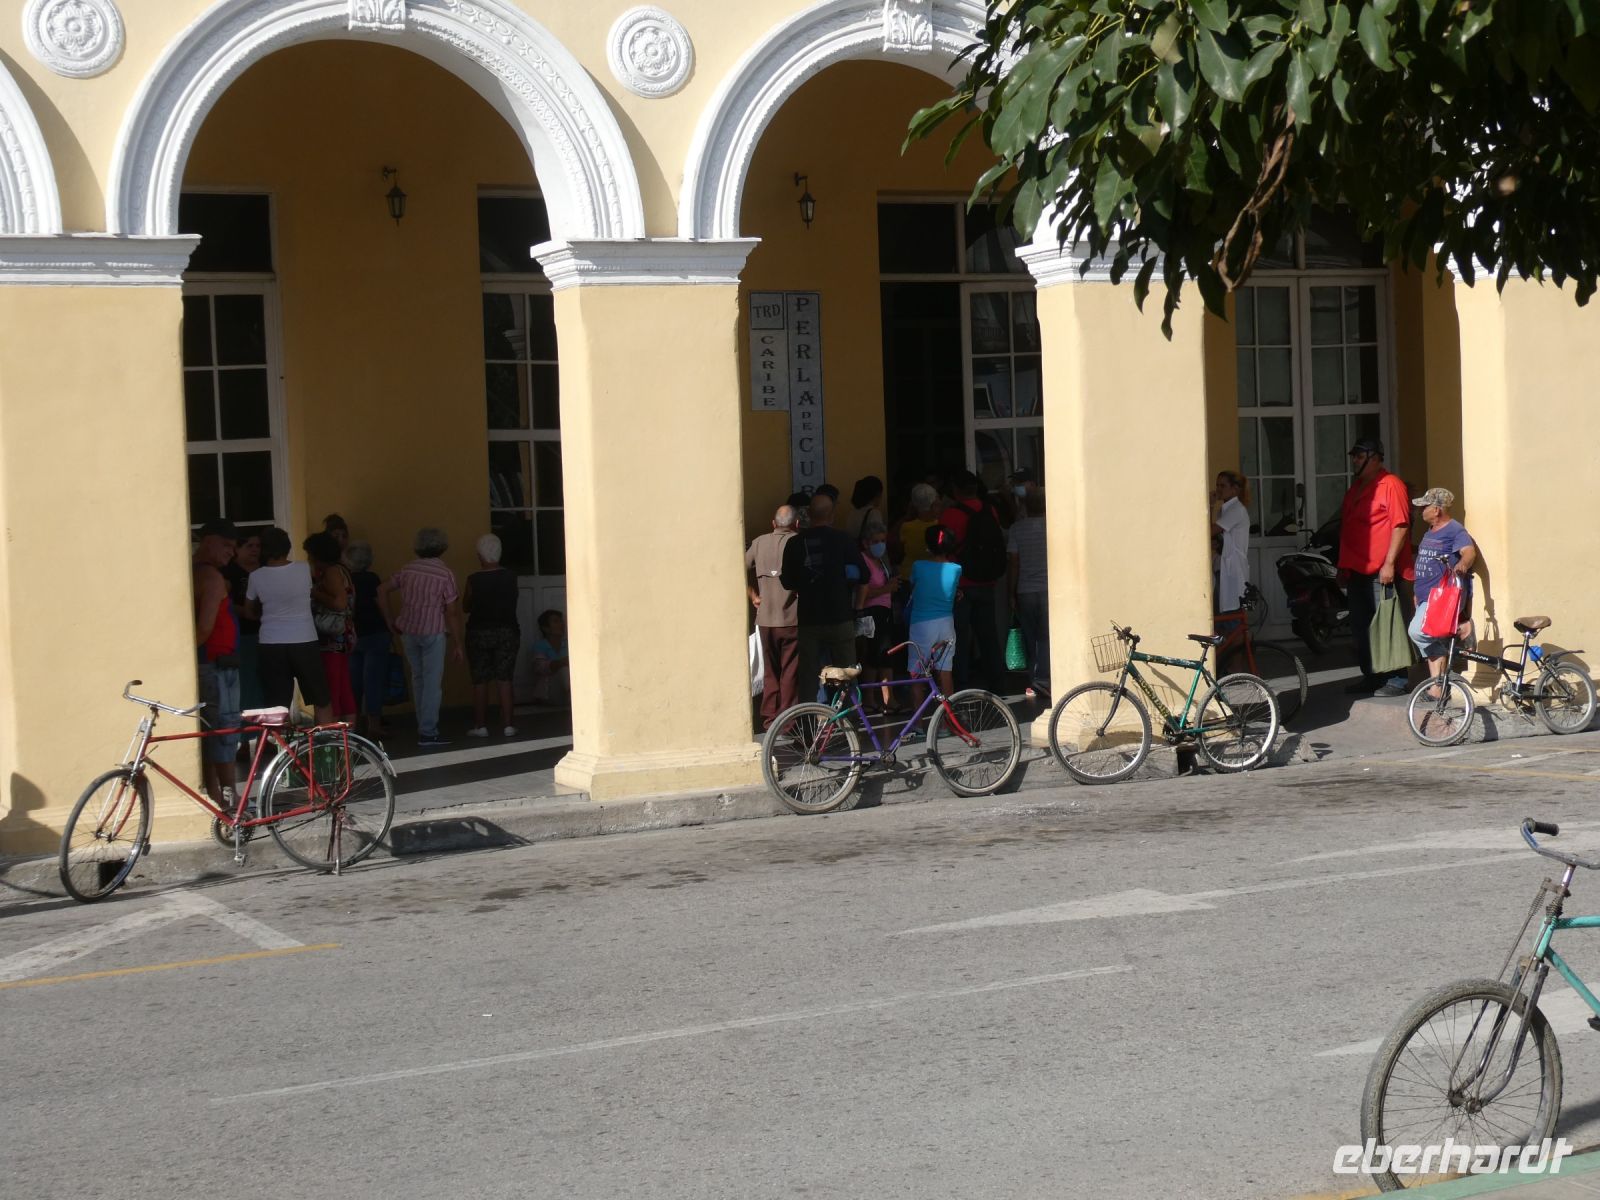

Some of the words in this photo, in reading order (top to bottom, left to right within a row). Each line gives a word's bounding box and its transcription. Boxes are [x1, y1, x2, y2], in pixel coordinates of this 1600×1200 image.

[752, 303, 781, 319] TRD
[760, 335, 776, 407] CARIBE
[796, 297, 815, 406] PERLA
[801, 411, 813, 431] DE
